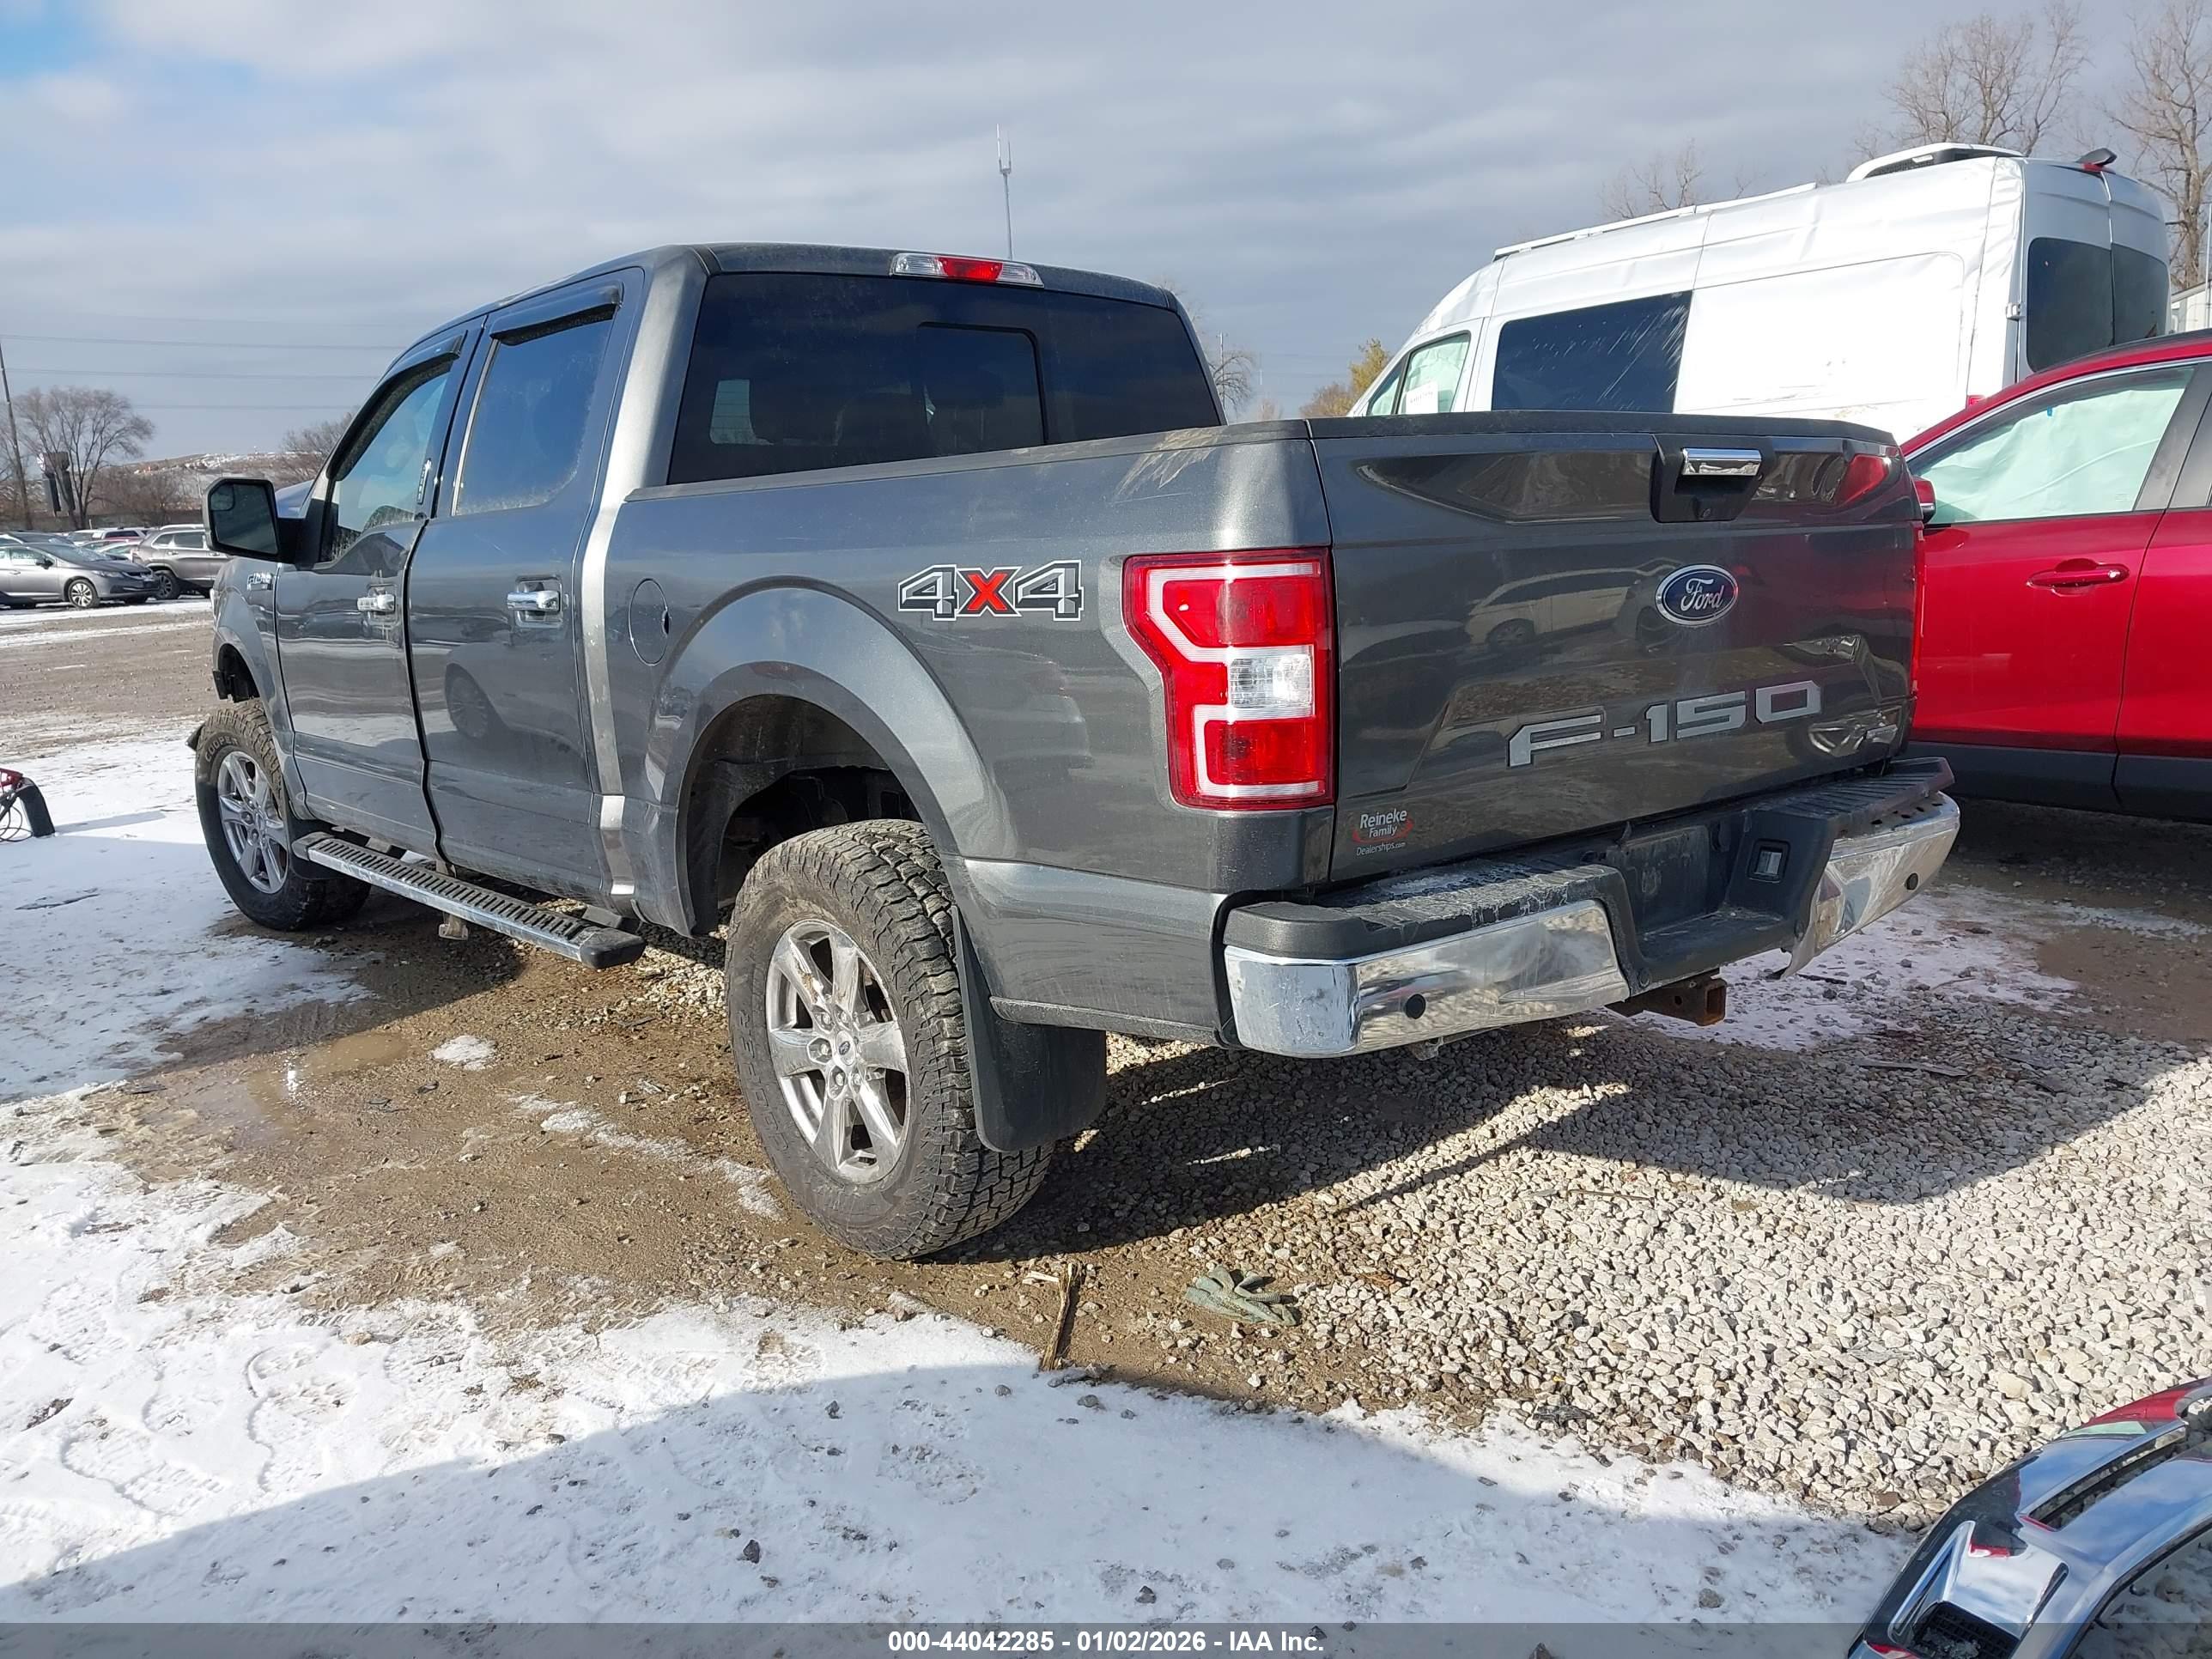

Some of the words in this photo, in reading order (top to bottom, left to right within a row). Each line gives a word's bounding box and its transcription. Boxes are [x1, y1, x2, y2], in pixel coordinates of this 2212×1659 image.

[1680, 578, 1725, 611] Ford
[1508, 680, 1822, 768] F-150
[1359, 808, 1407, 830] Reineke
[1369, 824, 1398, 838] Family
